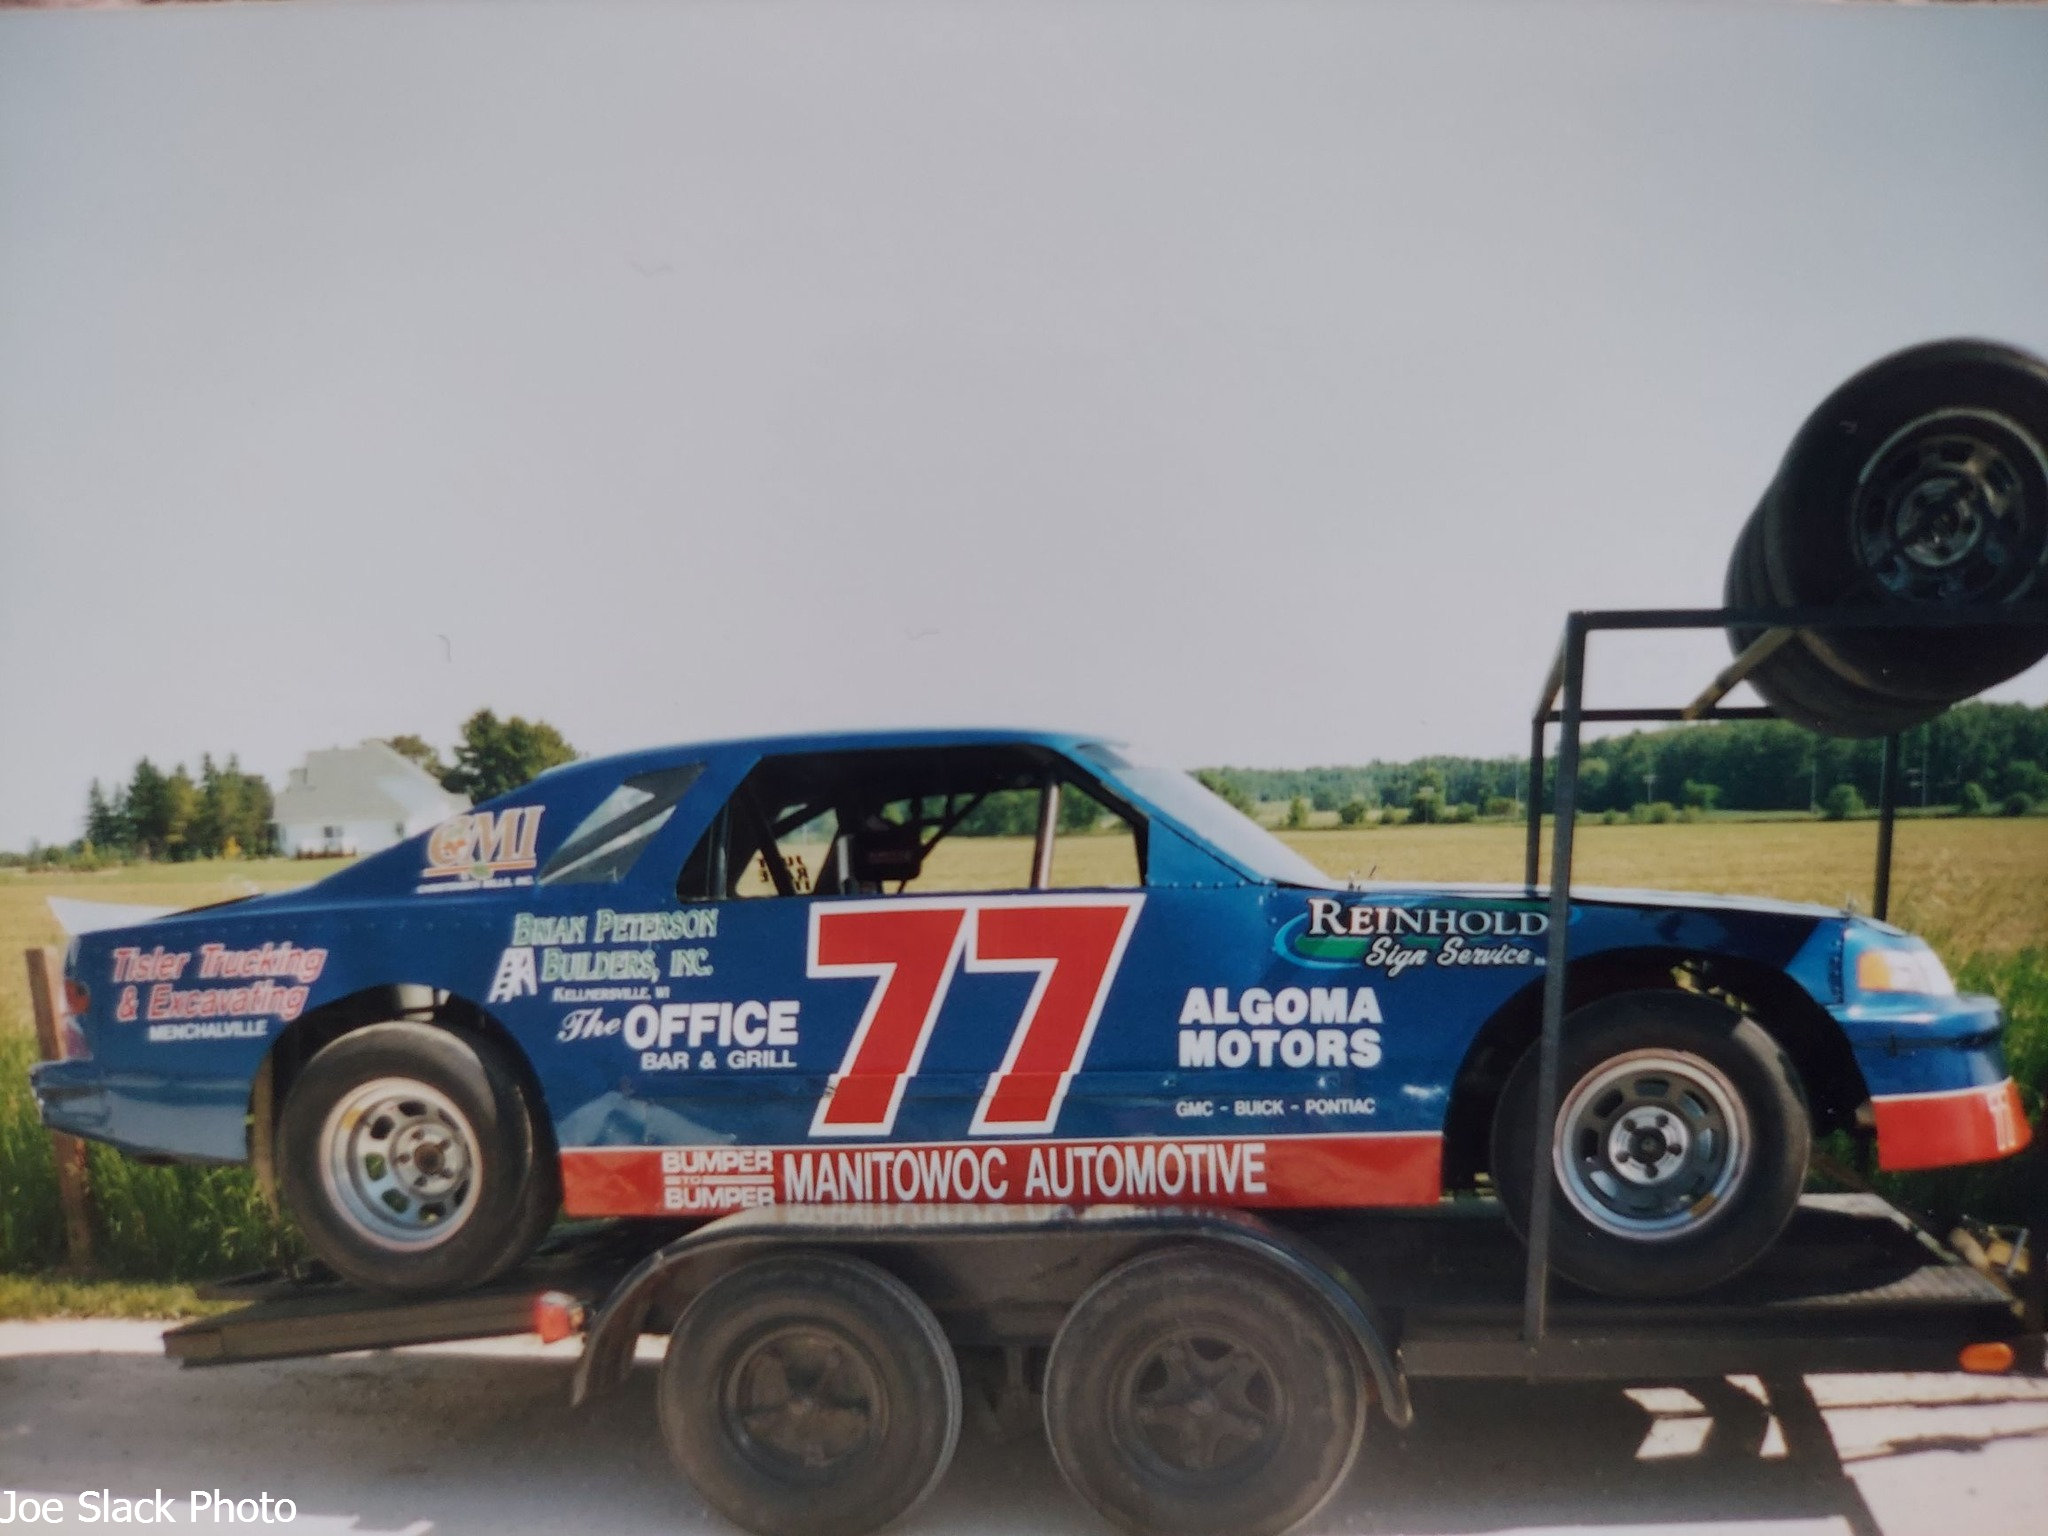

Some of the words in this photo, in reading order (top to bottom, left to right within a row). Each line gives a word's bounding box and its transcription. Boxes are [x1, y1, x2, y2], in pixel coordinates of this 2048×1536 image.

[512, 912, 588, 946] BRIAN
[594, 908, 719, 944] PETERSON
[1307, 898, 1550, 936] REINHOLD
[199, 941, 328, 983] Trucking
[669, 948, 714, 977] INC.
[1365, 937, 1428, 977] Sign
[1436, 936, 1533, 966] Service
[117, 985, 138, 1021] &
[147, 979, 309, 1022] Excavating
[806, 892, 1147, 1136] 77
[1178, 987, 1383, 1025] ALGOMA
[556, 1006, 621, 1043] The
[623, 1000, 799, 1050] OFFICE
[641, 1051, 689, 1071] BAR
[699, 1051, 716, 1069] &
[727, 1050, 797, 1068] GRILL
[1178, 1028, 1383, 1069] MOTORS
[1175, 1101, 1214, 1117] GMC
[1234, 1099, 1285, 1115] BUICK
[1305, 1097, 1376, 1115] PONTIAC
[662, 1150, 773, 1172] BUMPER
[783, 1147, 1008, 1201] MANITOWOC
[1025, 1143, 1267, 1197] AUTOMOTIVE
[664, 1186, 775, 1209] BUMPER
